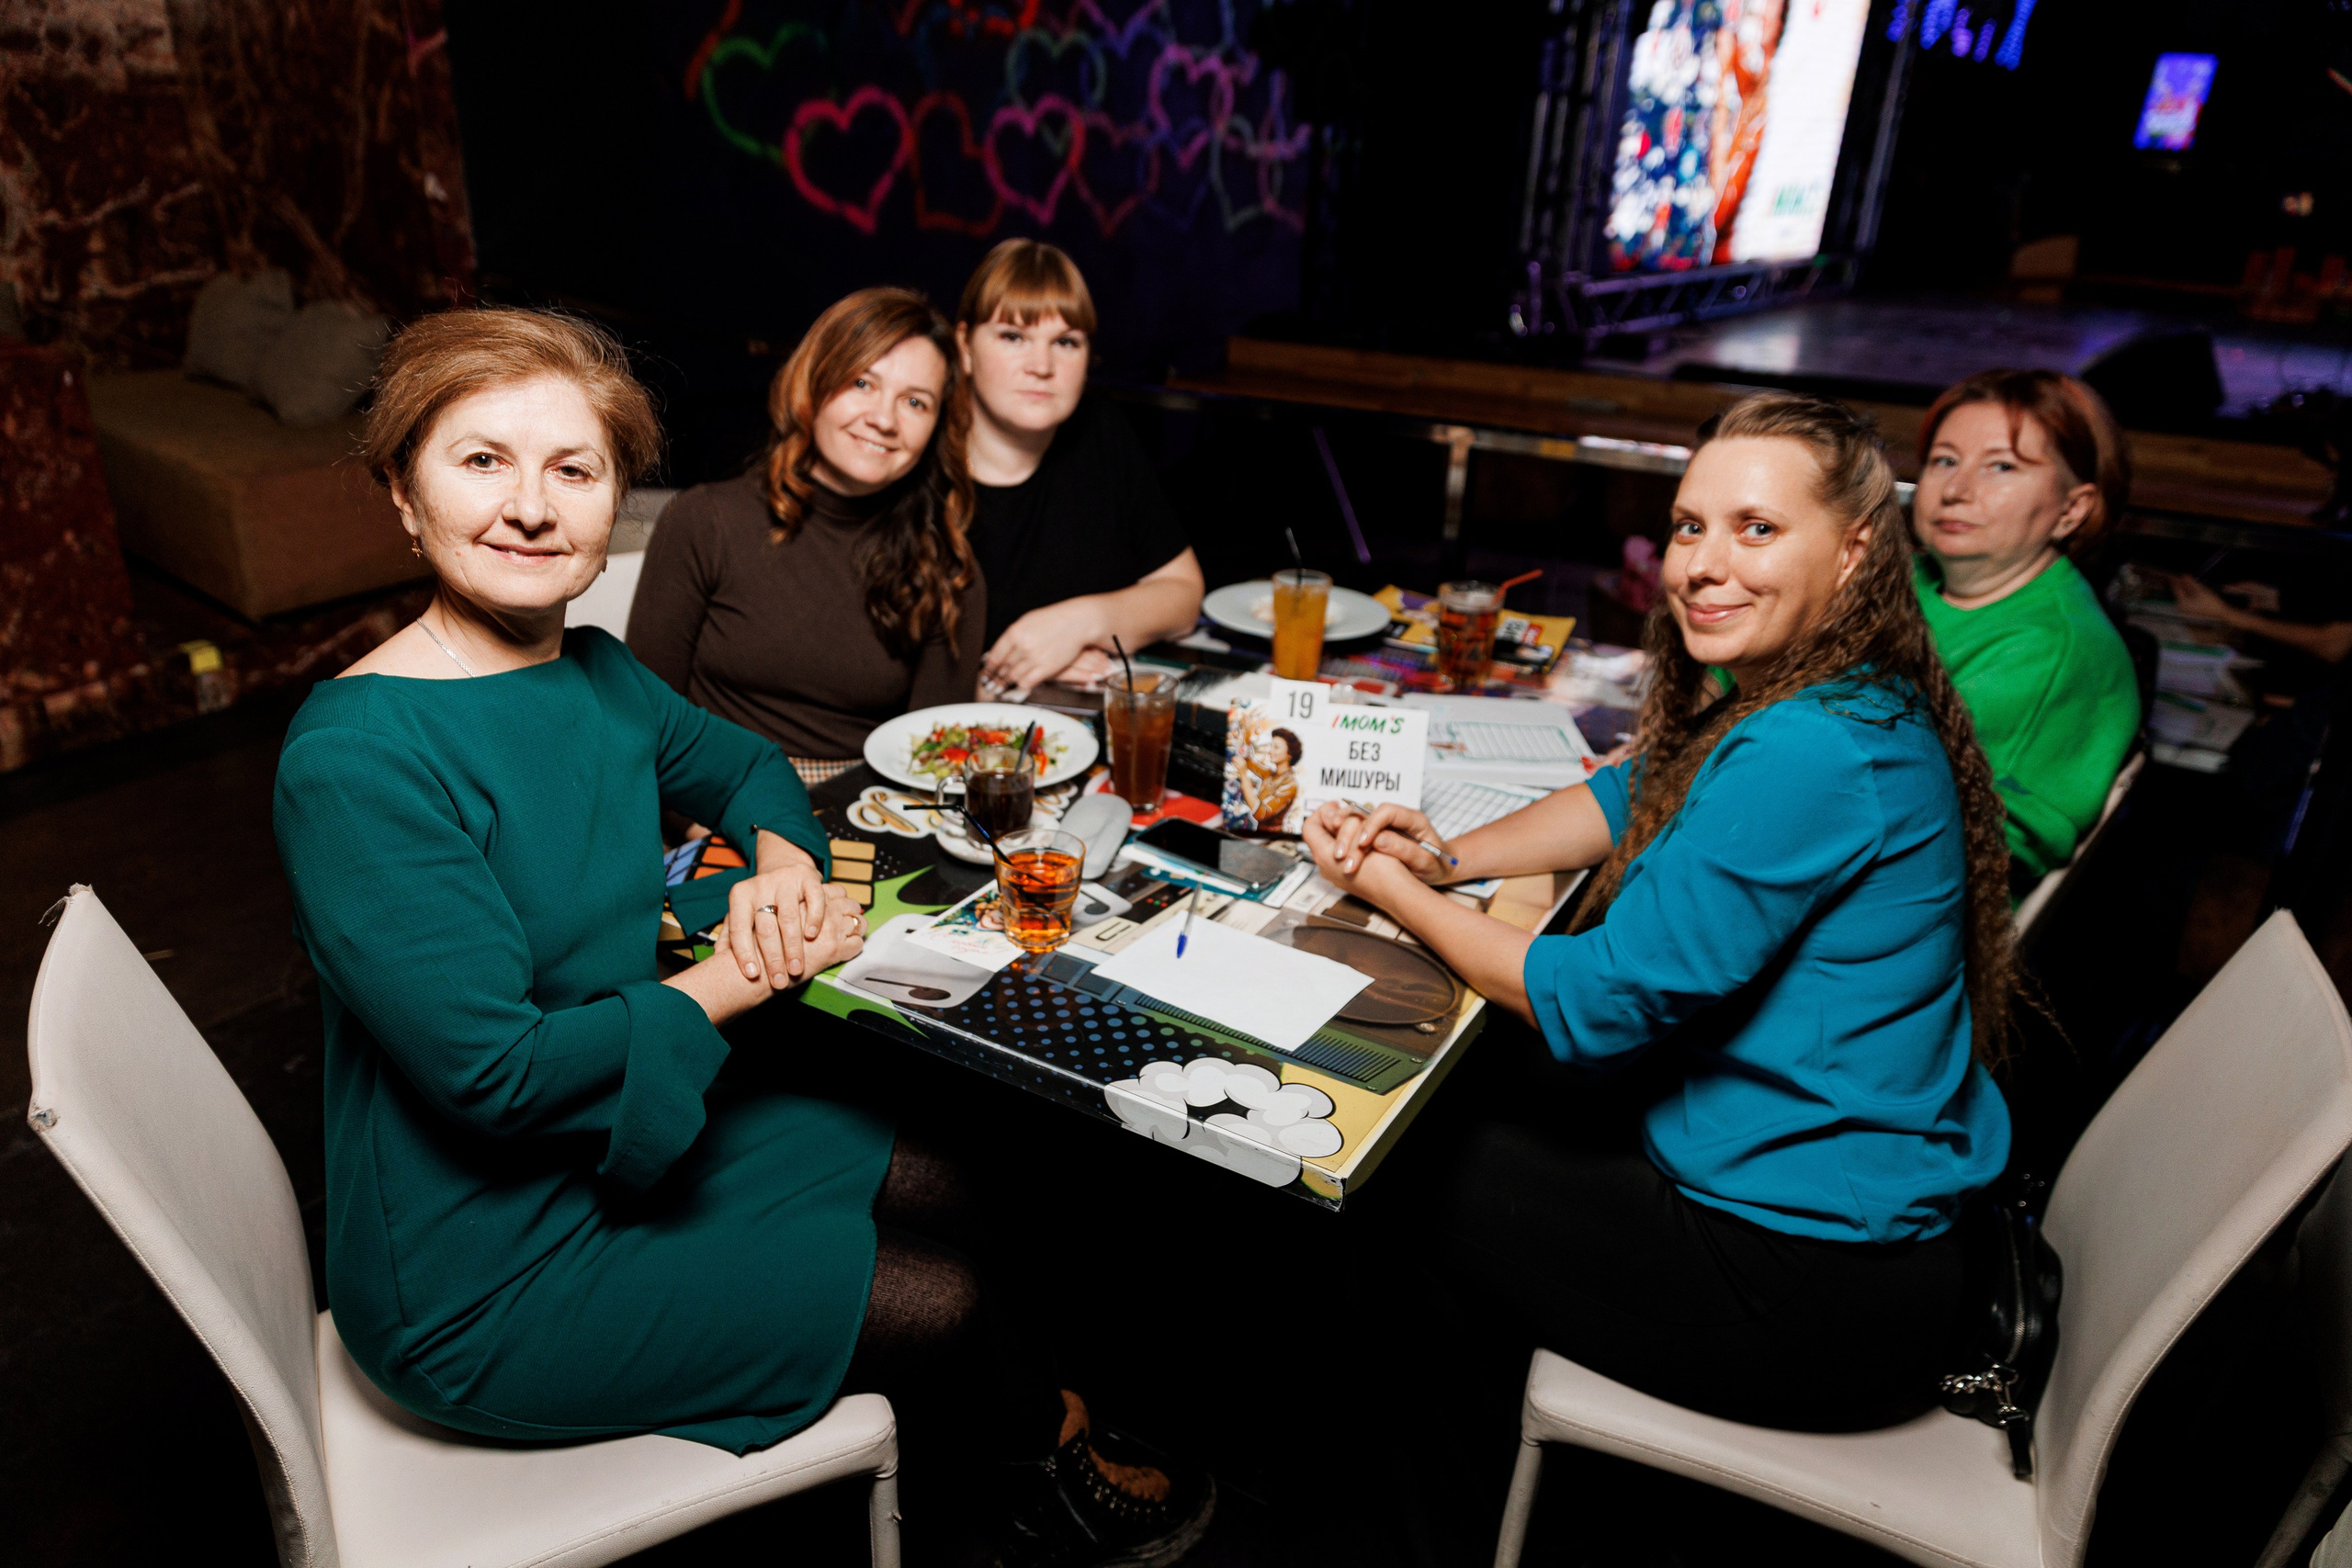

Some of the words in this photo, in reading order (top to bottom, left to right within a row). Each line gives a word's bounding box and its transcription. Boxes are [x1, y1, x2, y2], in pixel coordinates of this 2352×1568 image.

[1288, 690, 1314, 719] 19
[1349, 740, 1381, 761] БЕЗ
[1320, 767, 1401, 792] МИШУРЫ
